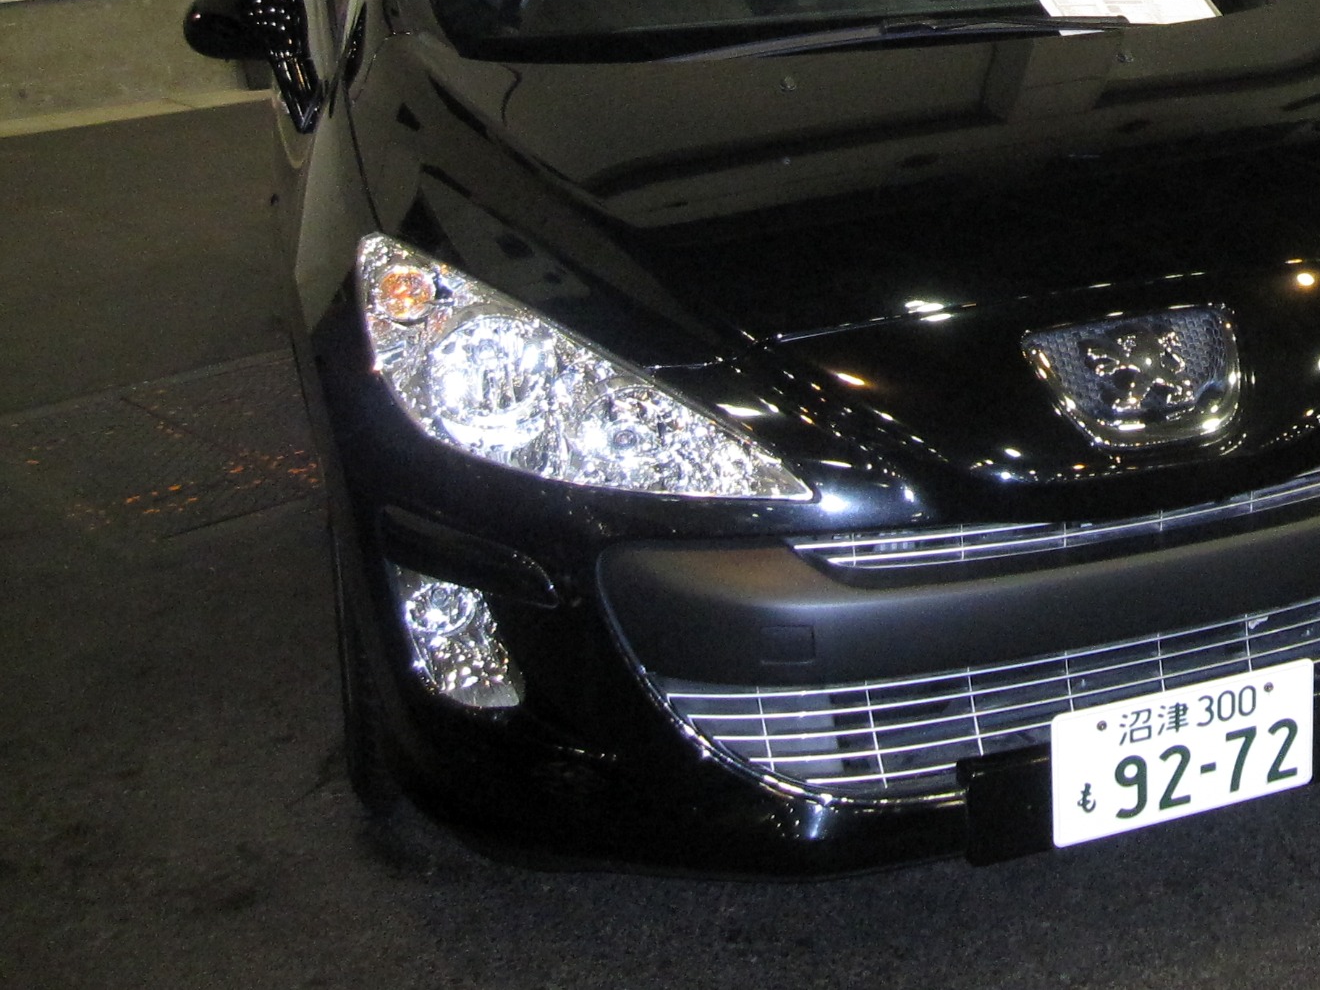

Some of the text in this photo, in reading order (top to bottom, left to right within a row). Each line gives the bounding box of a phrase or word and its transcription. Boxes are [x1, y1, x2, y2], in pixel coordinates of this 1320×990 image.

[1118, 685, 1258, 747] 沼津 300
[1076, 717, 1299, 820] も 92-72
